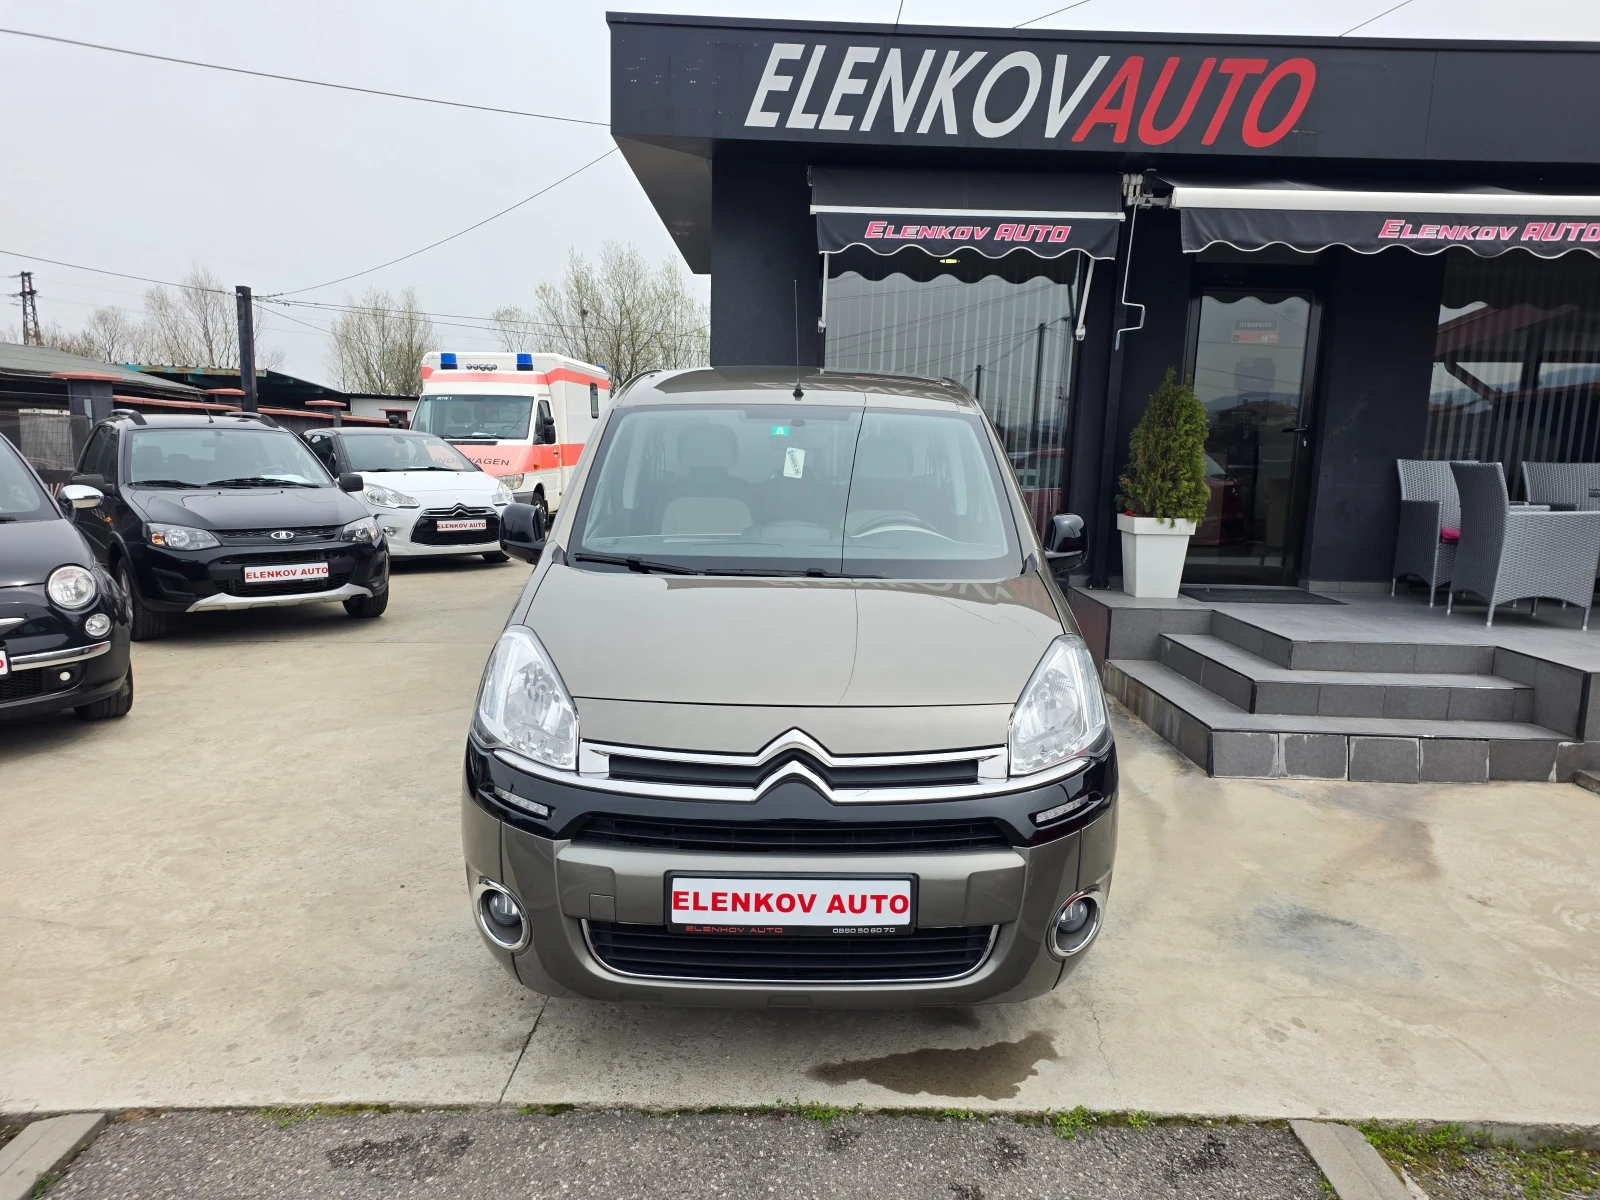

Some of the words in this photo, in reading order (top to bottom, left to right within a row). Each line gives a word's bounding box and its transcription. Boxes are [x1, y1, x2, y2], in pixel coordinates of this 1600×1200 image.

[864, 221, 991, 240] ELENKOV
[994, 224, 1072, 243] AUTO
[1378, 219, 1519, 241] ELENKOV
[1520, 222, 1600, 241] AUTO
[437, 522, 468, 530] ELENKOV
[245, 569, 297, 580] ELENKOV
[300, 566, 329, 576] AUTO
[672, 890, 817, 914] ELENKOV
[826, 894, 909, 914] AUTO
[685, 925, 745, 933] ELENKOV
